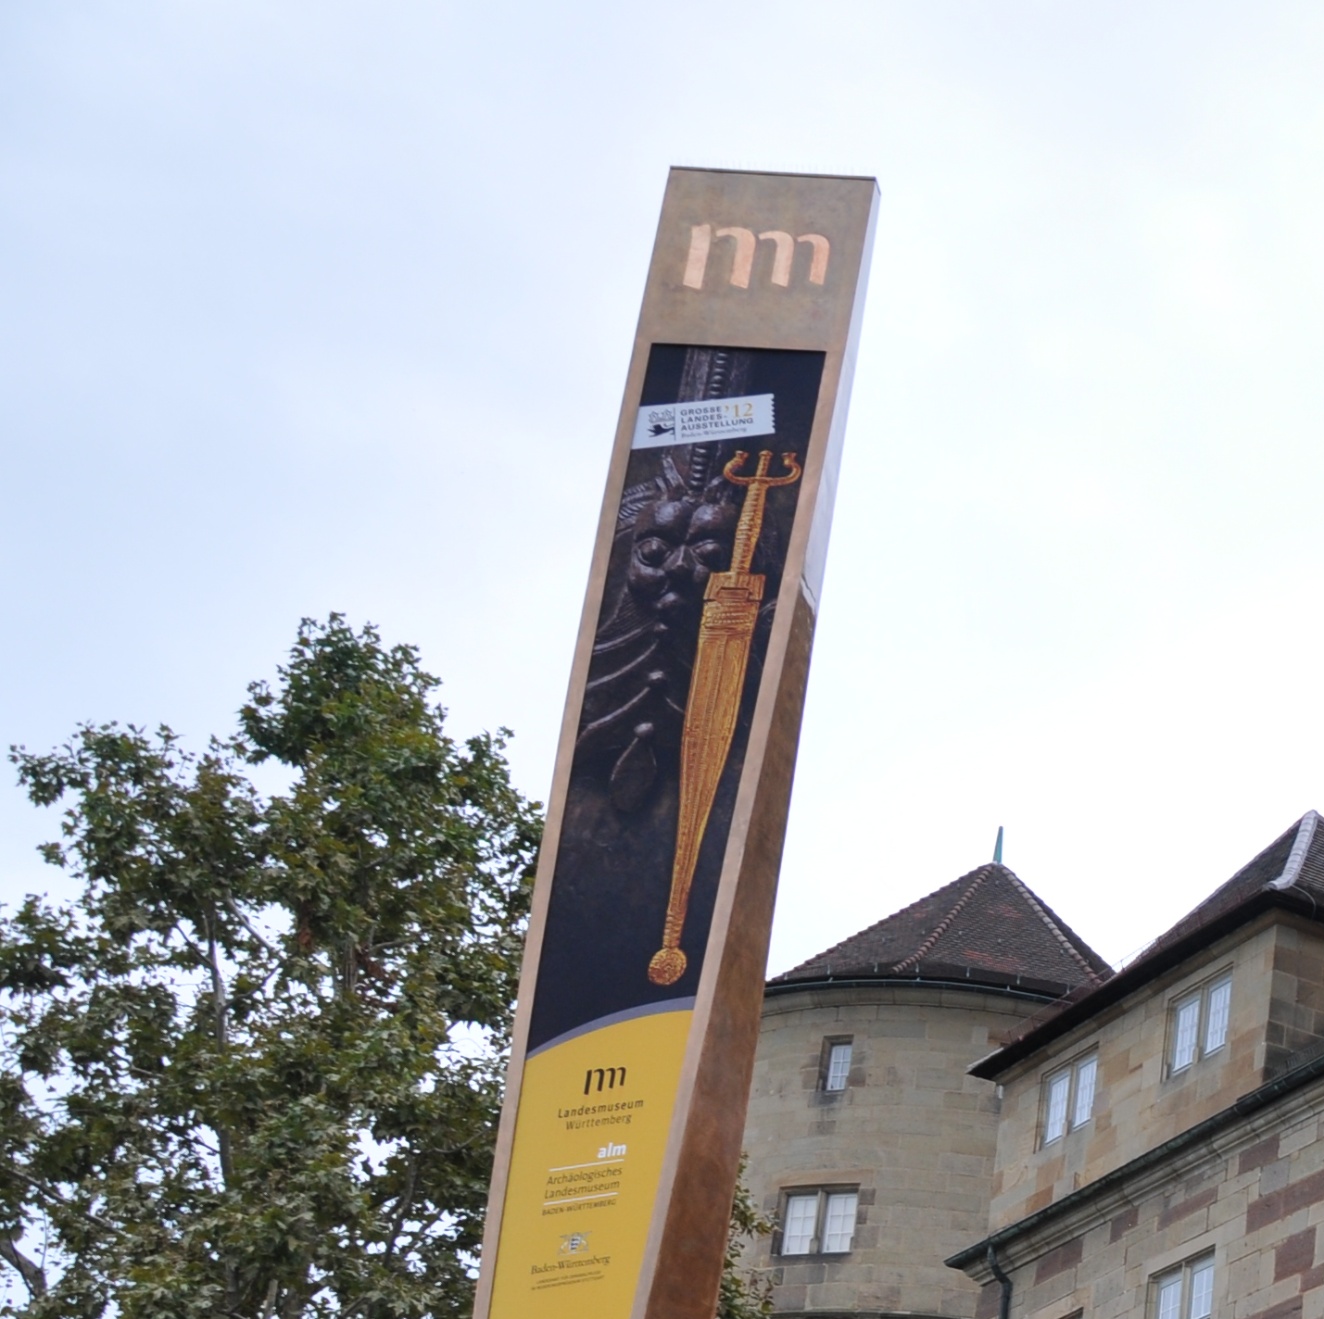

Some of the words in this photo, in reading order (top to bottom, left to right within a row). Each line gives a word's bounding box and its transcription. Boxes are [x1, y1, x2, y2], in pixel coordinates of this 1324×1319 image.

[680, 406, 722, 416] GROSSE
[681, 414, 728, 424] LANDES-
[680, 418, 754, 431] AUSSTELLUNG
[558, 1100, 644, 1118] Landesmuseum
[566, 1114, 632, 1130] Württemberg
[598, 1142, 626, 1158] alm
[546, 1166, 622, 1186] Archäologisches
[544, 1180, 620, 1200] Landesmuseum
[542, 1199, 616, 1216] BADEN-WÜRTTEMBERG
[531, 1256, 610, 1274] Baden-Württemberg
